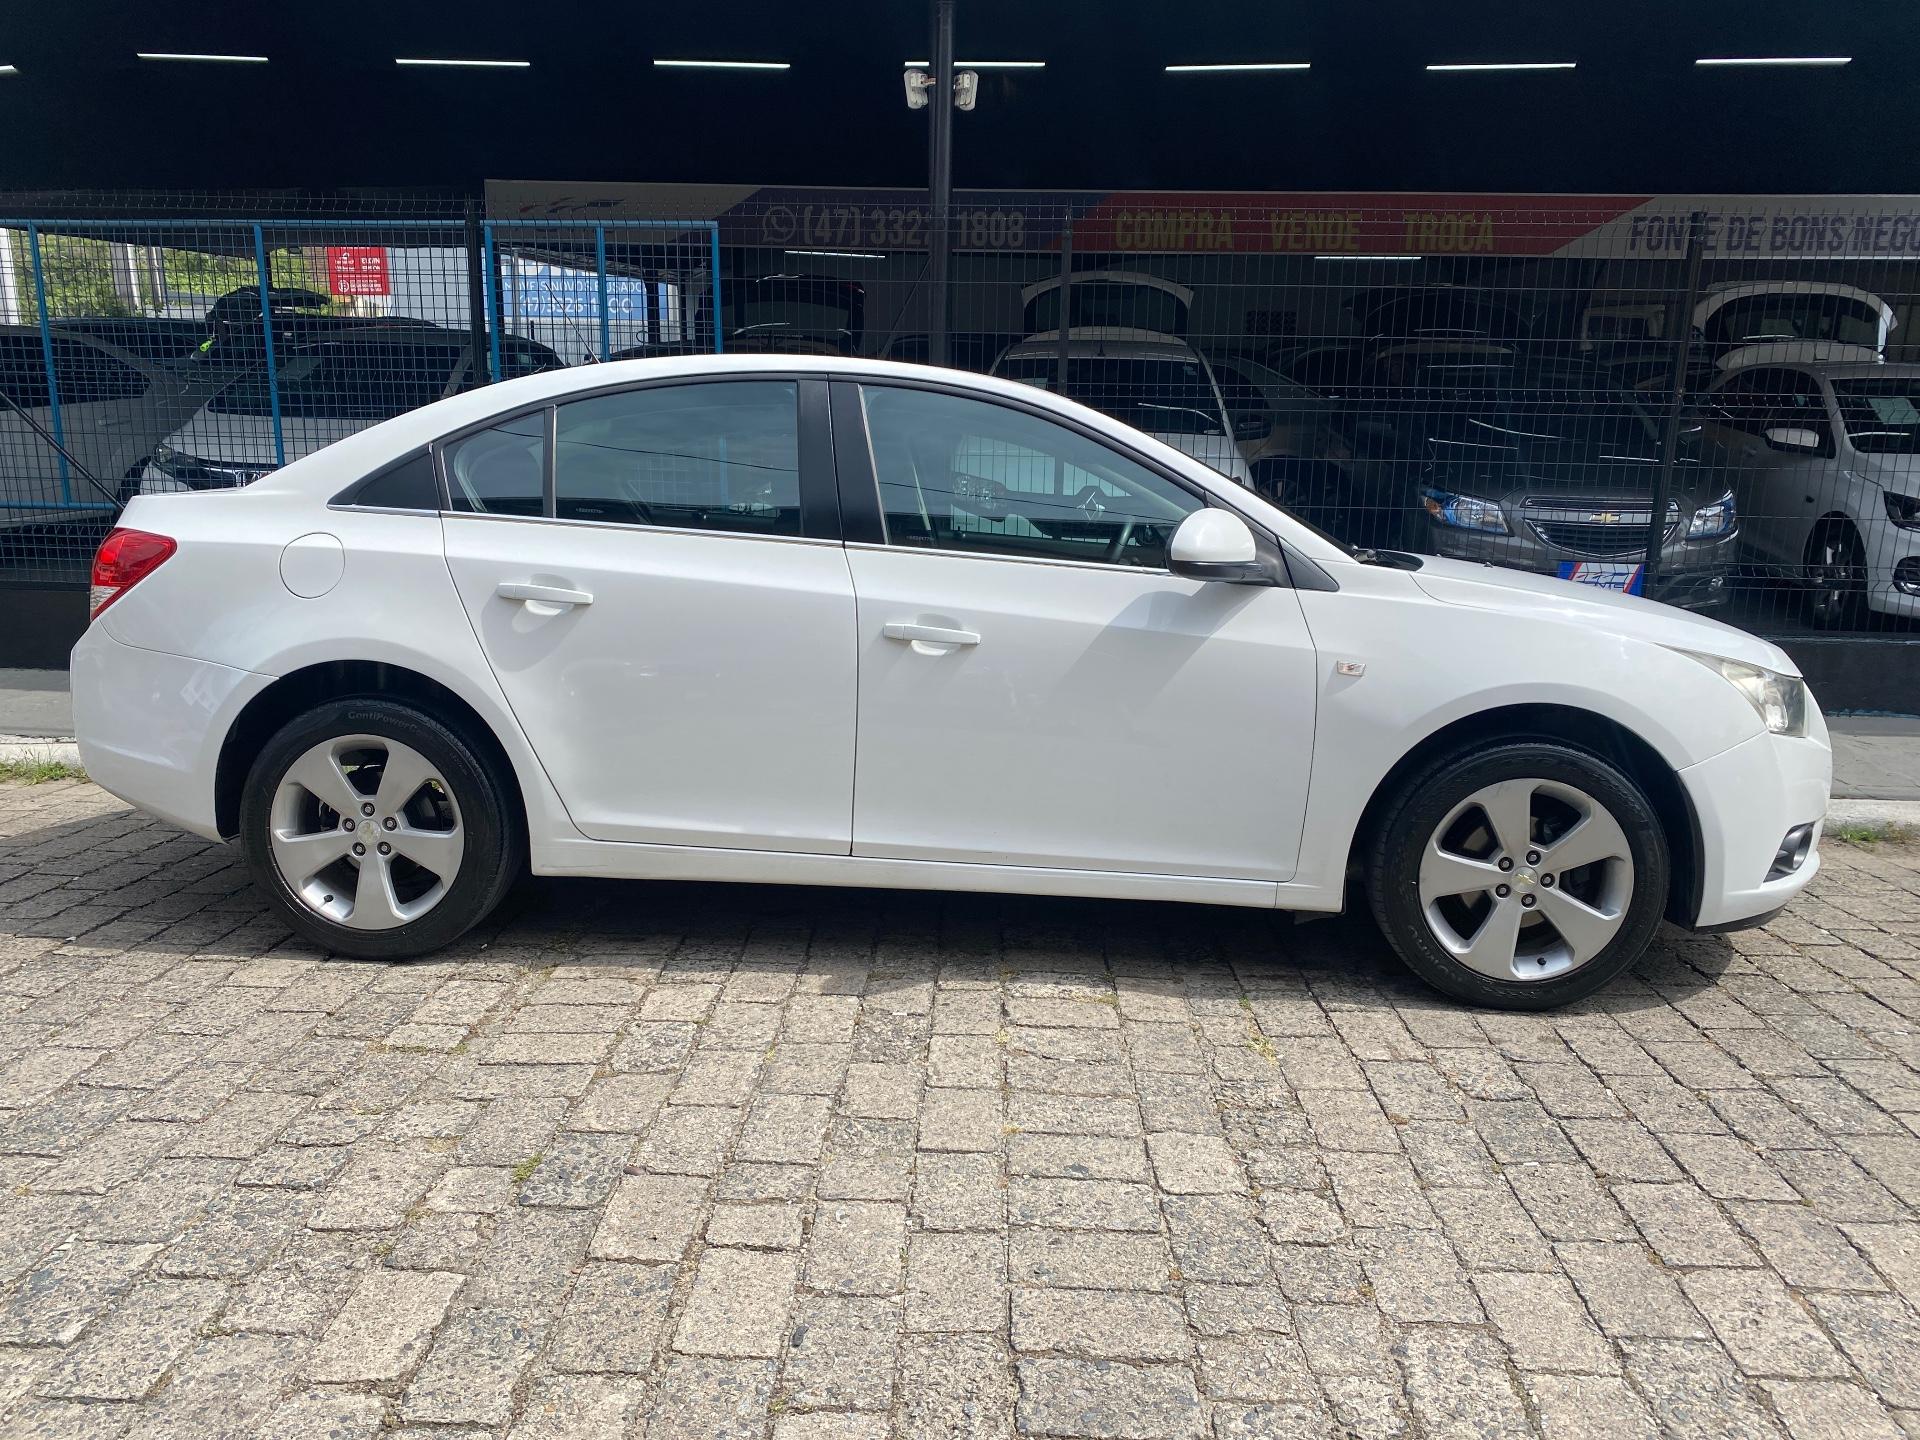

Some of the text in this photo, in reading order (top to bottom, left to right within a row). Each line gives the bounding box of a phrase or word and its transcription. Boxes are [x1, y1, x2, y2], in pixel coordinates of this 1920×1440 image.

[803, 205, 1025, 248] (47) 332 1808
[1114, 210, 1495, 252] COMPRA VENDE TROCA
[1629, 215, 1721, 252] FONE
[1725, 215, 1765, 252] DE
[1769, 215, 1847, 252] BONS
[605, 281, 647, 293] USADO
